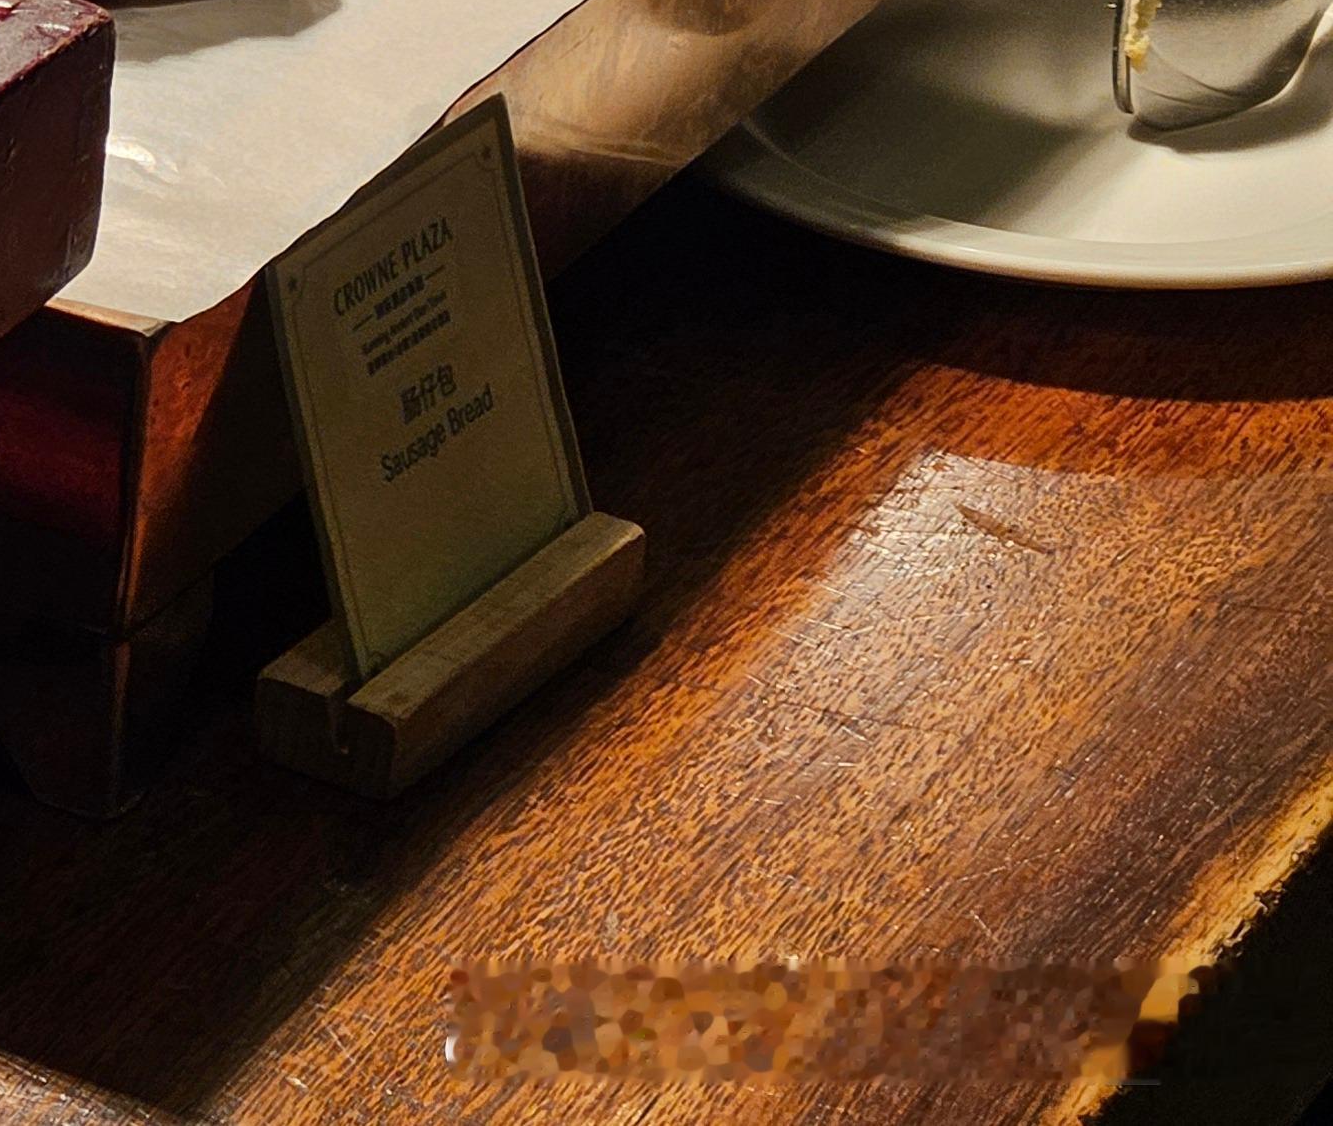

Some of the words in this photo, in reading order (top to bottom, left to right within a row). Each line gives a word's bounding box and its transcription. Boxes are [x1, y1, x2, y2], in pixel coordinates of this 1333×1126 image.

[333, 248, 400, 316] CROWNE
[401, 216, 453, 269] PLAZA
[380, 418, 447, 483] Sausage
[447, 382, 494, 438] Bread
